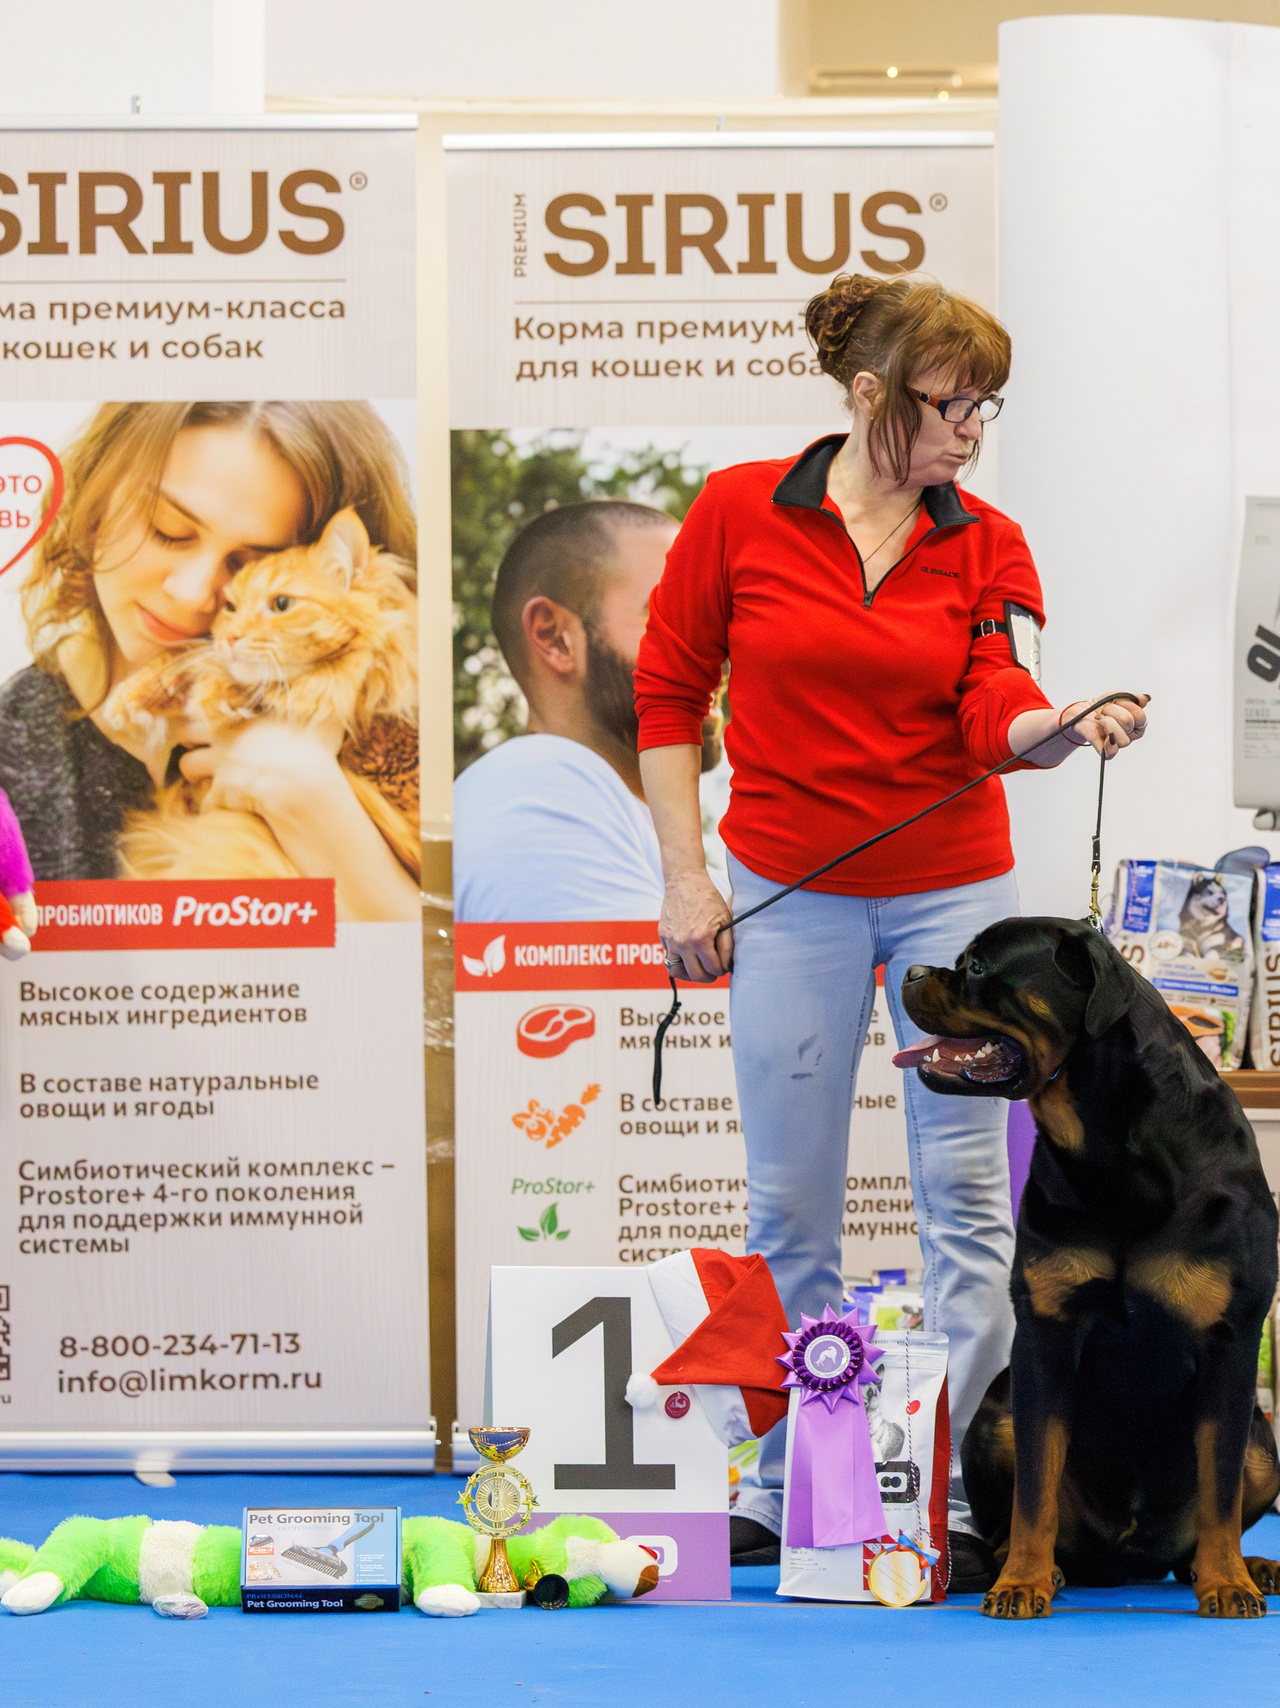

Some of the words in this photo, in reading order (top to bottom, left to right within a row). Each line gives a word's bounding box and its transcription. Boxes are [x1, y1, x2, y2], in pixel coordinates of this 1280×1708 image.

[513, 193, 527, 278] PREMIUM
[544, 190, 926, 277] SIRIUS
[49, 300, 345, 326] премиум-класса
[514, 317, 624, 344] Корма
[3, 340, 117, 359] кошек
[130, 341, 148, 358] и
[162, 333, 264, 359] собак
[516, 360, 578, 382] для
[592, 358, 703, 378] кошек
[716, 359, 734, 377] и
[172, 895, 318, 928] ProStor+
[515, 943, 613, 967] КОМПЛЕКС
[616, 943, 665, 966] ПРОБ
[20, 981, 134, 1002] Высокое
[141, 981, 301, 1004] содержание
[20, 1008, 119, 1027] мясных
[127, 1005, 308, 1029] ингредиентов
[620, 1033, 712, 1050] мяных
[20, 1073, 36, 1094] В
[43, 1075, 142, 1093] составе
[148, 1073, 320, 1096] натуральные
[20, 1099, 106, 1121] овощи
[113, 1101, 127, 1117] и
[134, 1099, 214, 1119] ягоды
[620, 1094, 634, 1112] В
[642, 1096, 733, 1112] составе
[620, 1119, 699, 1137] овощи
[706, 1120, 719, 1134] и
[19, 1156, 241, 1182] Симбиотический
[248, 1160, 374, 1179] комплекс
[20, 1184, 146, 1206] Prostore+
[153, 1183, 209, 1203] 4-го
[216, 1184, 355, 1204] поколения
[511, 1177, 596, 1195] ProStor+
[19, 1214, 65, 1234] для
[73, 1211, 223, 1234] поддержки
[229, 1204, 364, 1231] иммунной
[620, 1198, 736, 1217] Prostore+
[619, 1224, 662, 1242] для
[20, 1237, 130, 1255] системы
[60, 1332, 301, 1359] 8-800-234-71-13
[57, 1367, 322, 1398] info@limkorm.ru
[552, 1296, 676, 1490] 1
[249, 1514, 273, 1524] Pet
[276, 1512, 351, 1525] Grooming
[354, 1512, 384, 1523] Tool
[247, 1600, 265, 1608] Pet
[267, 1599, 320, 1609] Grooming
[321, 1599, 344, 1607] Tool
